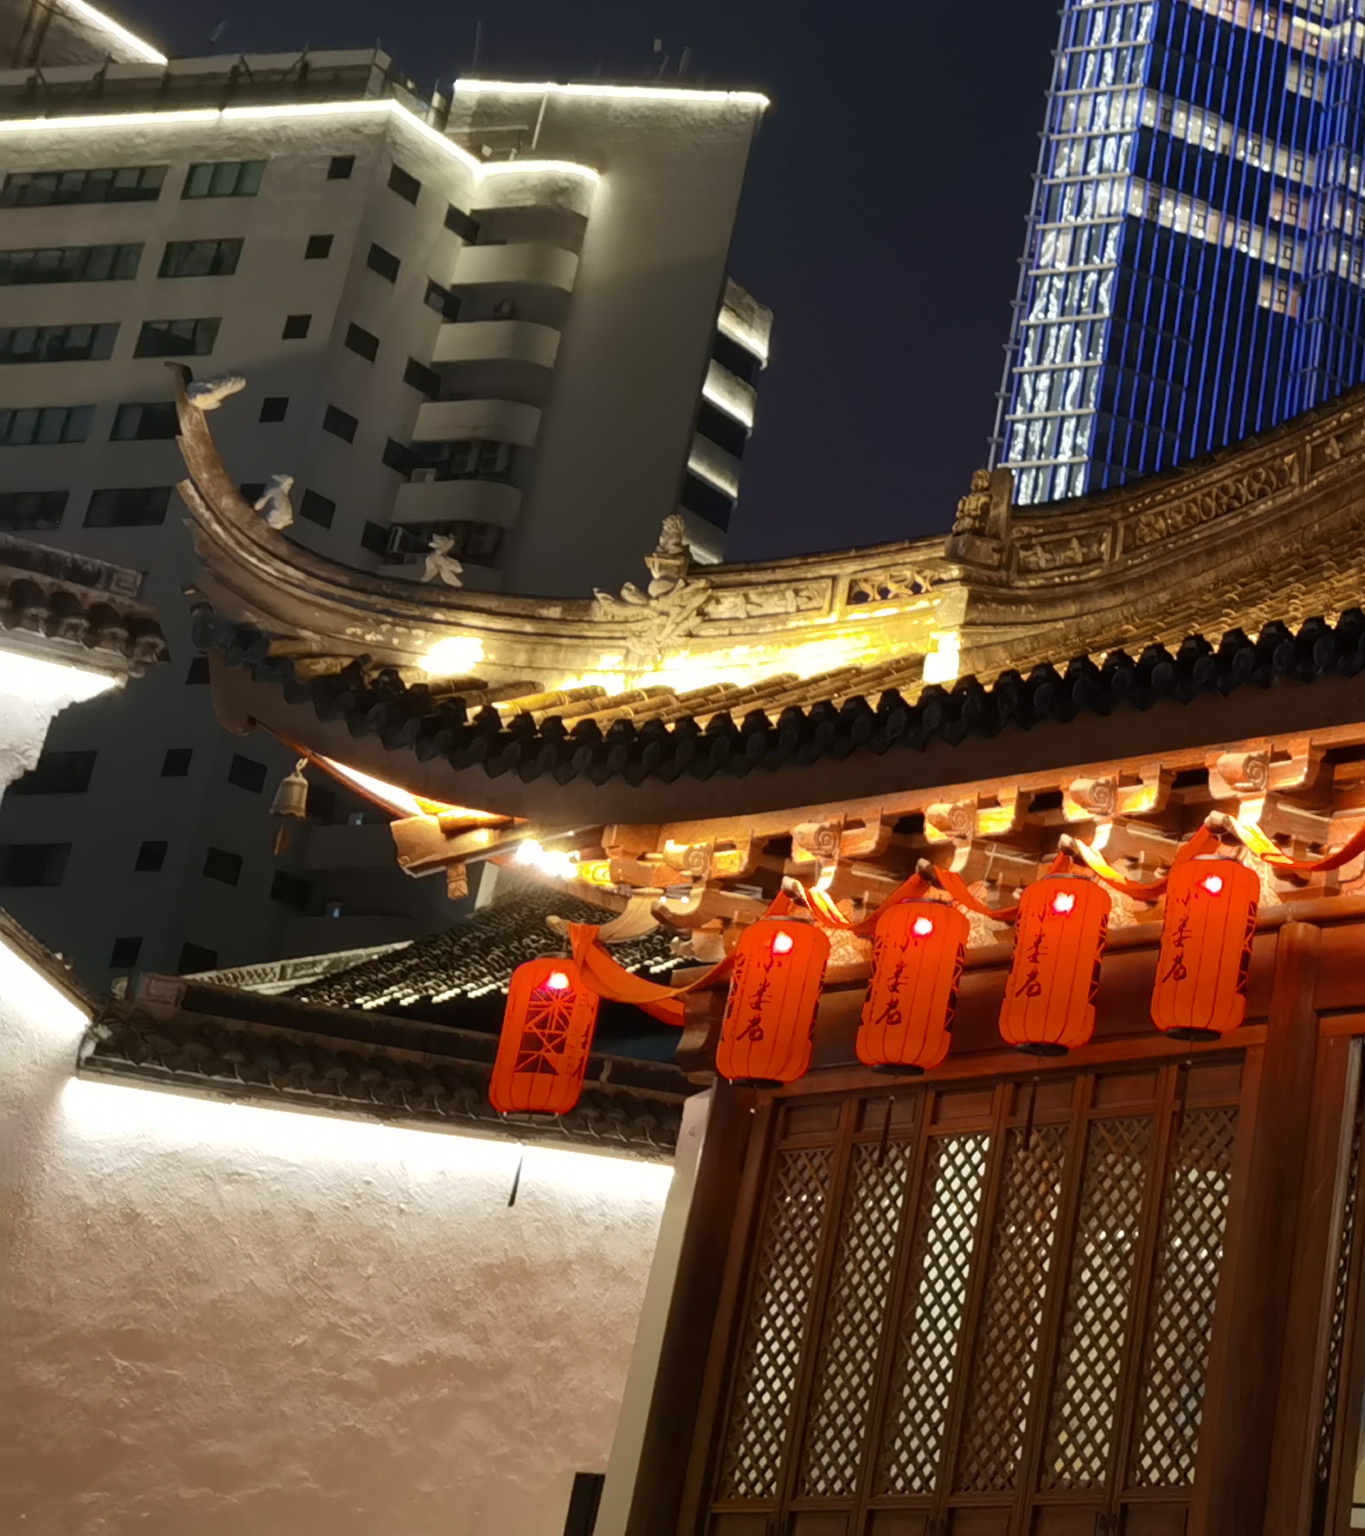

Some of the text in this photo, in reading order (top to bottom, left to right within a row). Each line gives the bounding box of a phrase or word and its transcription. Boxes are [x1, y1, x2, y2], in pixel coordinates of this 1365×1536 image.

[876, 935, 919, 1026] 小娄巷
[1162, 891, 1199, 983] 小娄巷
[737, 954, 783, 1042] 小娄巷
